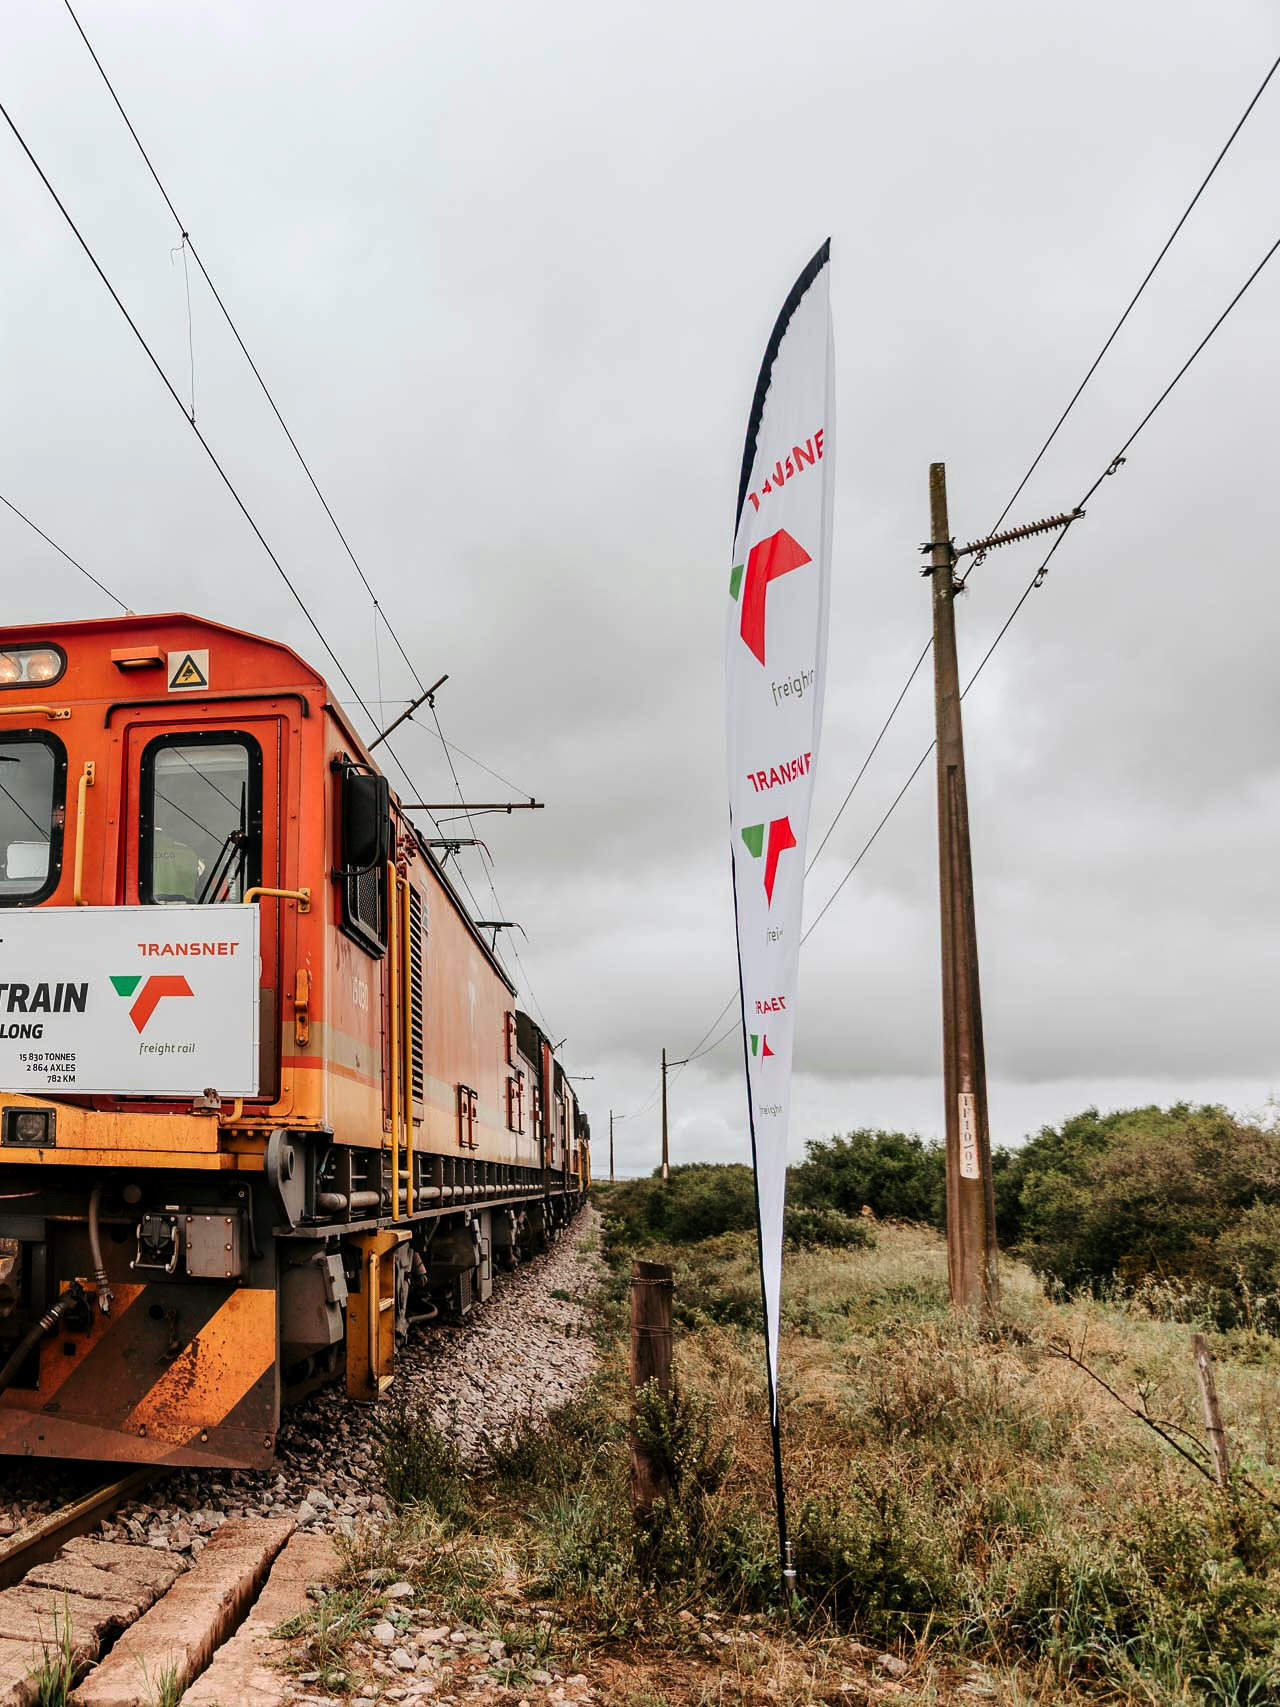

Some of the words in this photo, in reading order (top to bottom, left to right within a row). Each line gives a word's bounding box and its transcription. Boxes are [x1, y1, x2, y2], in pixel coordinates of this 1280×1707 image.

[137, 942, 240, 957] TRANSNET
[139, 1042, 176, 1056] freight
[177, 1042, 196, 1054] rail
[28, 1052, 44, 1062] 830
[44, 1052, 76, 1062] TONNES
[26, 1064, 32, 1072] 2
[32, 1063, 49, 1073] 864
[49, 1063, 76, 1072] AXLES
[46, 1074, 62, 1084] 782
[62, 1074, 76, 1083] KM
